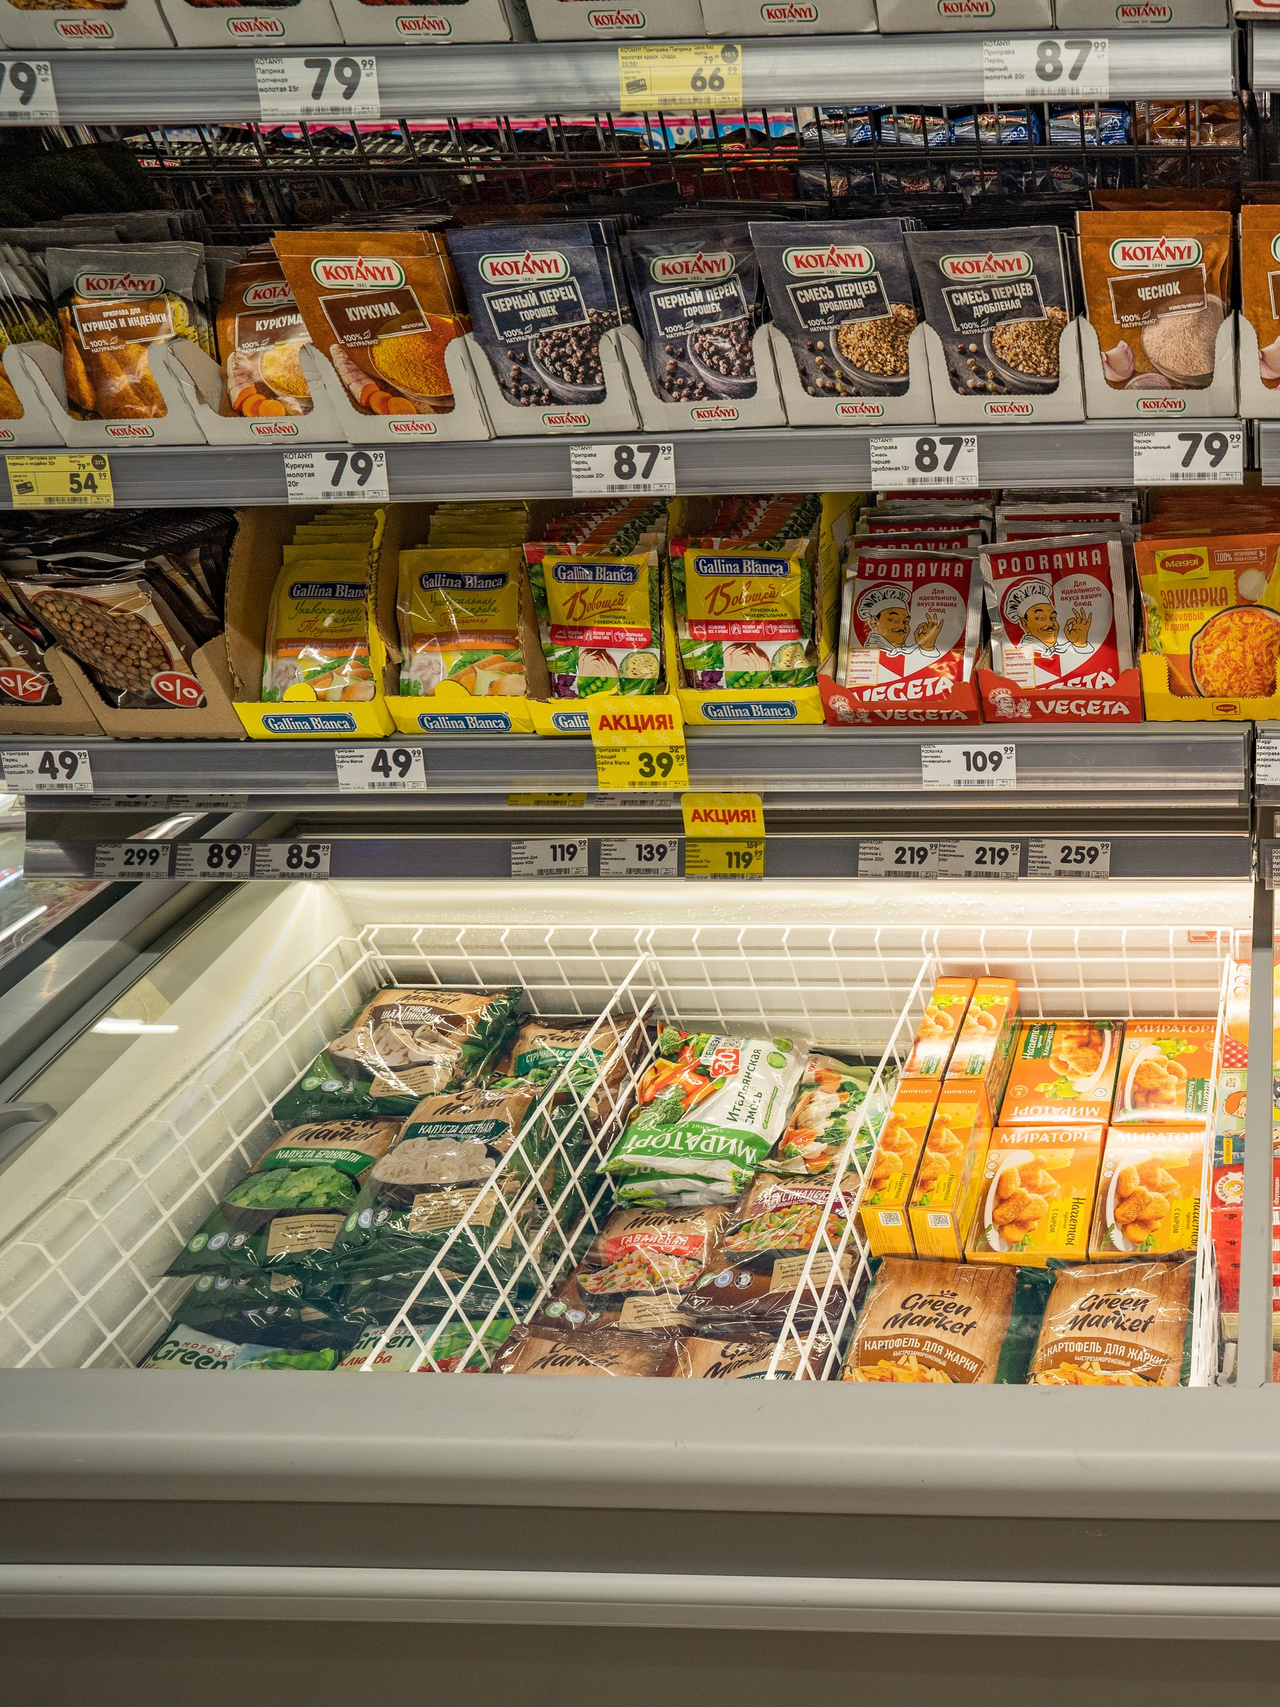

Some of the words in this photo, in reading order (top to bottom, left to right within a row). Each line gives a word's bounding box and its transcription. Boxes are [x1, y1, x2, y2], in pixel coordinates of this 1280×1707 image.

[1035, 40, 1092, 82] 87
[304, 57, 361, 100] 79
[362, 60, 374, 70] 99
[690, 68, 724, 92] 66
[491, 290, 536, 312] ЧЕРНЫЙ
[539, 285, 576, 304] ПЕРЕЦ
[952, 289, 990, 306] СМЕСЬ
[992, 282, 1034, 300] ПЕРЦЕВ
[1137, 281, 1181, 302] ЧЕСНОК
[345, 301, 400, 322] КУРКУМА
[520, 306, 557, 322] ГОРОШЕК
[973, 300, 1021, 318] ДРОБЛЕНАЯ
[82, 317, 118, 333] КУРИЦЫ
[120, 318, 126, 328] И
[128, 312, 167, 328] ИНДЕЙКИ
[915, 438, 964, 472] 87
[1178, 432, 1229, 468] 79
[285, 462, 314, 470] Куркума
[325, 452, 373, 486] 79
[373, 453, 384, 462] 99
[614, 446, 660, 480] 87
[70, 473, 98, 494] 54
[288, 480, 299, 488] 20г
[864, 563, 964, 578] PODRAVKA
[998, 550, 1102, 574] PODRAVKA
[1165, 558, 1198, 568] Maggi
[1160, 586, 1228, 610] ЗАЖАРКА
[707, 704, 750, 718] Gallina
[752, 704, 791, 718] Blanca
[1036, 700, 1130, 716] VEGETA
[268, 713, 311, 732] Gallina
[312, 716, 350, 730] Blanca
[424, 715, 465, 730] Gallina
[468, 716, 506, 729] Blanca
[598, 714, 674, 734] АКЦИЯ!
[38, 751, 78, 780] 49
[372, 749, 412, 778] 49
[638, 752, 673, 778] 39
[962, 751, 1003, 772] 109
[691, 810, 756, 824] АКЦИЯ!
[124, 849, 160, 866] 299
[207, 844, 242, 869] 89
[286, 844, 320, 869] 85
[550, 844, 578, 862] 119
[636, 844, 672, 862] 139
[726, 852, 752, 869] 119
[894, 846, 928, 864] 219
[1060, 846, 1099, 864] 259
[418, 1124, 458, 1134] КАПУСТА
[1001, 1132, 1089, 1144] МИРАТОРГ
[276, 1150, 314, 1159] КАПУСТА
[316, 1150, 362, 1163] БРОККОЛИ
[1072, 1196, 1086, 1246] Наггетсы
[901, 1293, 972, 1317] Green
[883, 1313, 977, 1336] Market
[865, 1338, 921, 1351] КАРТОФЕЛЬ
[923, 1340, 943, 1355] ДЛЯ
[944, 1345, 978, 1374] ЖАРКИ
